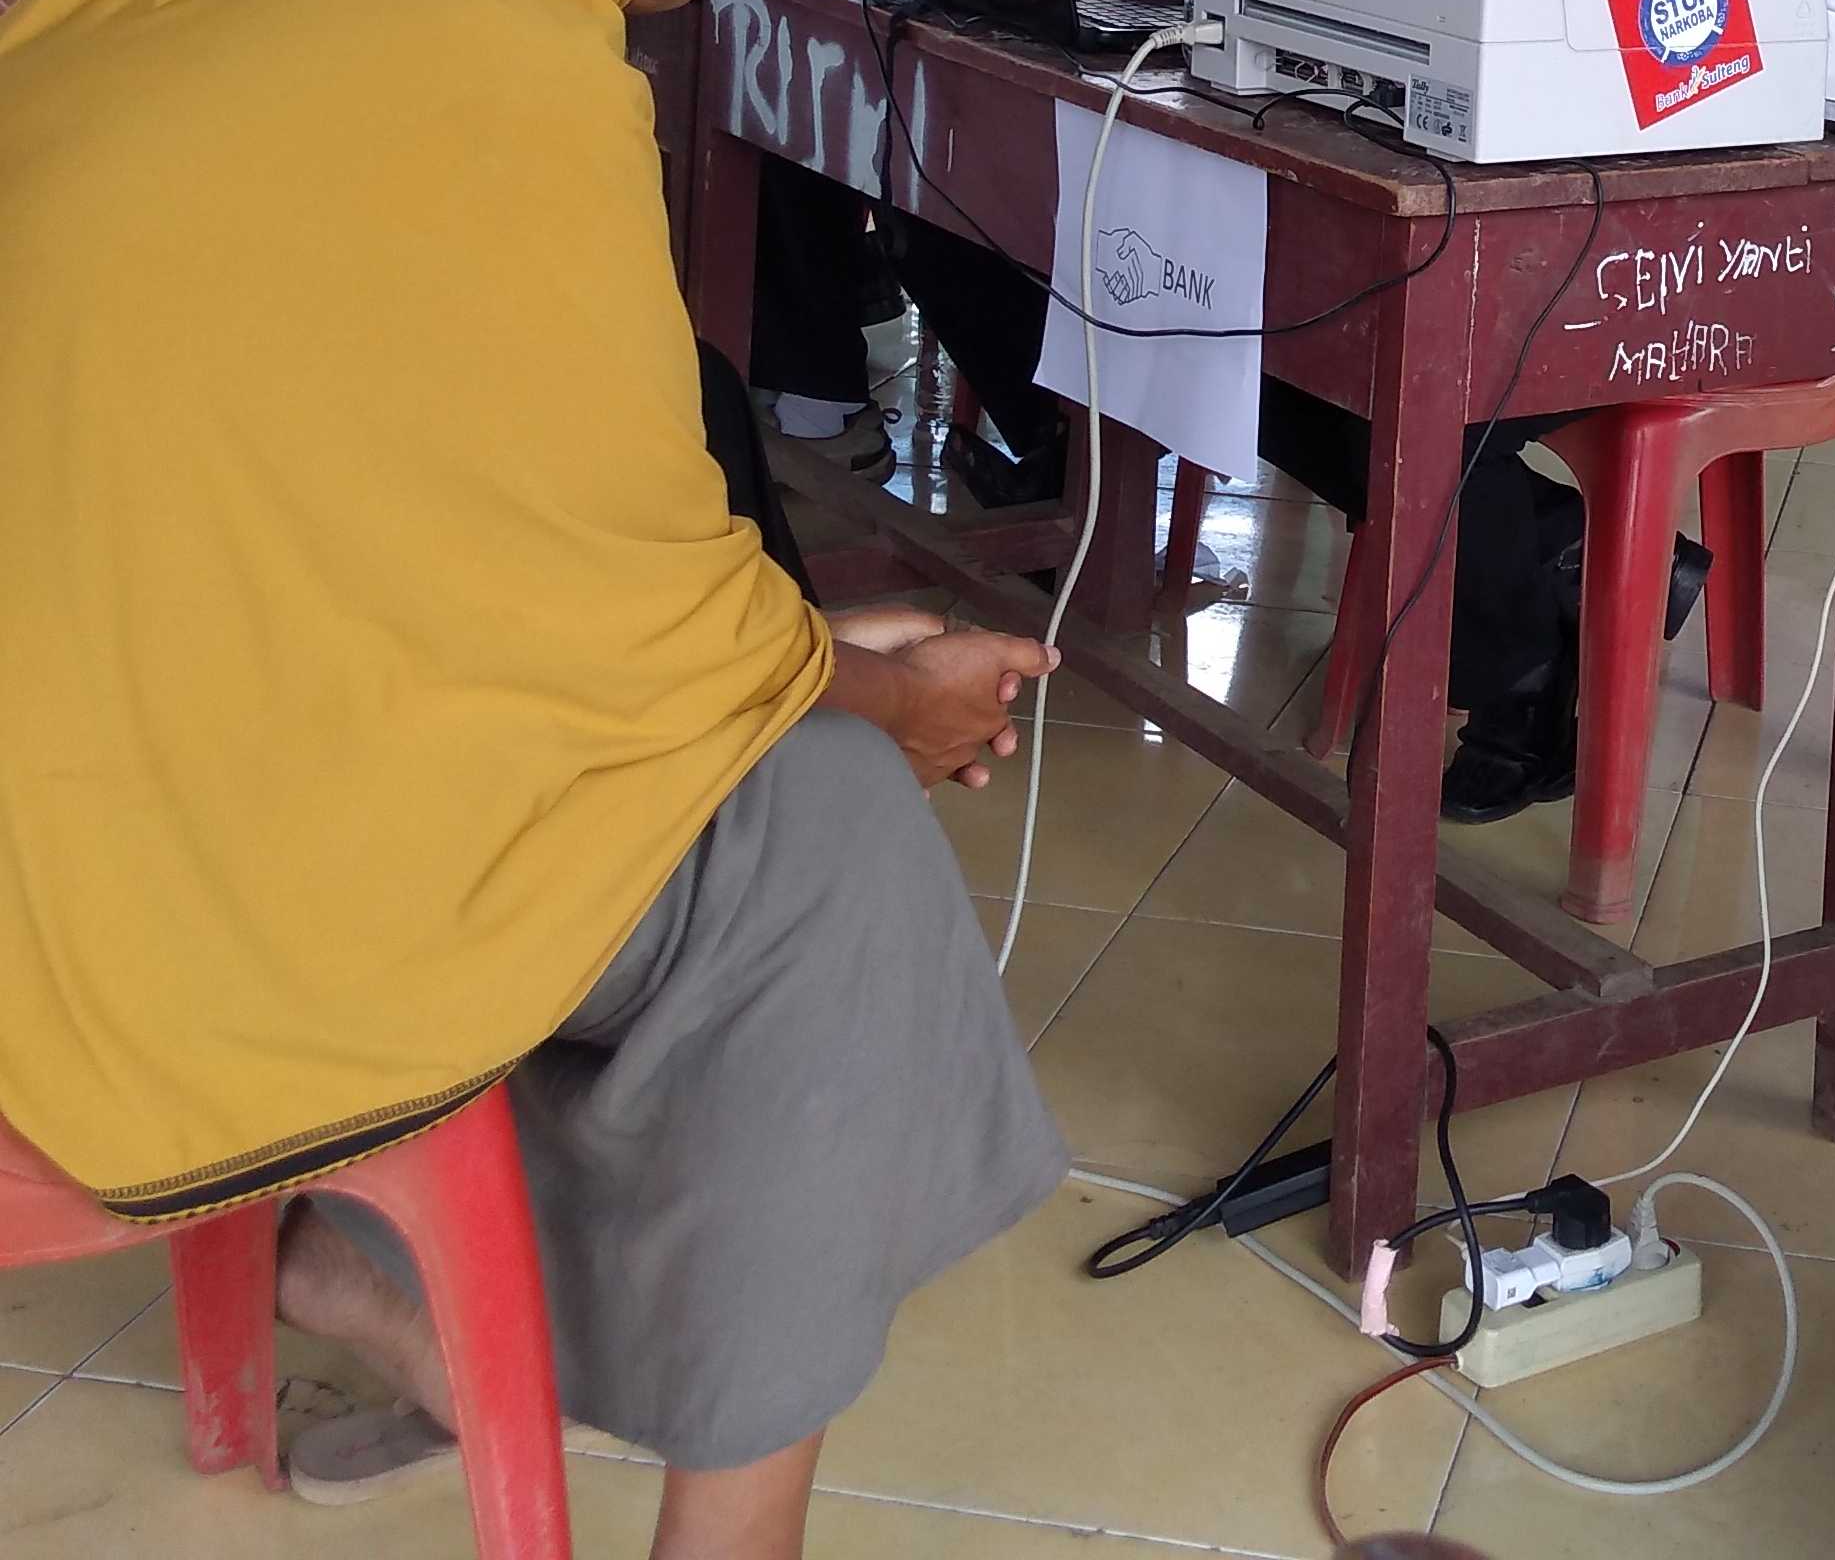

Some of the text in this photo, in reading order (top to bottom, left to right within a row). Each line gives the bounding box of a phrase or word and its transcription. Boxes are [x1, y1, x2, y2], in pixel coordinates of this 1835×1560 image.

[1660, 6, 1715, 41] NARKOBA
[1655, 55, 1750, 112] Bank Sulteng
[1162, 258, 1216, 310] BANK
